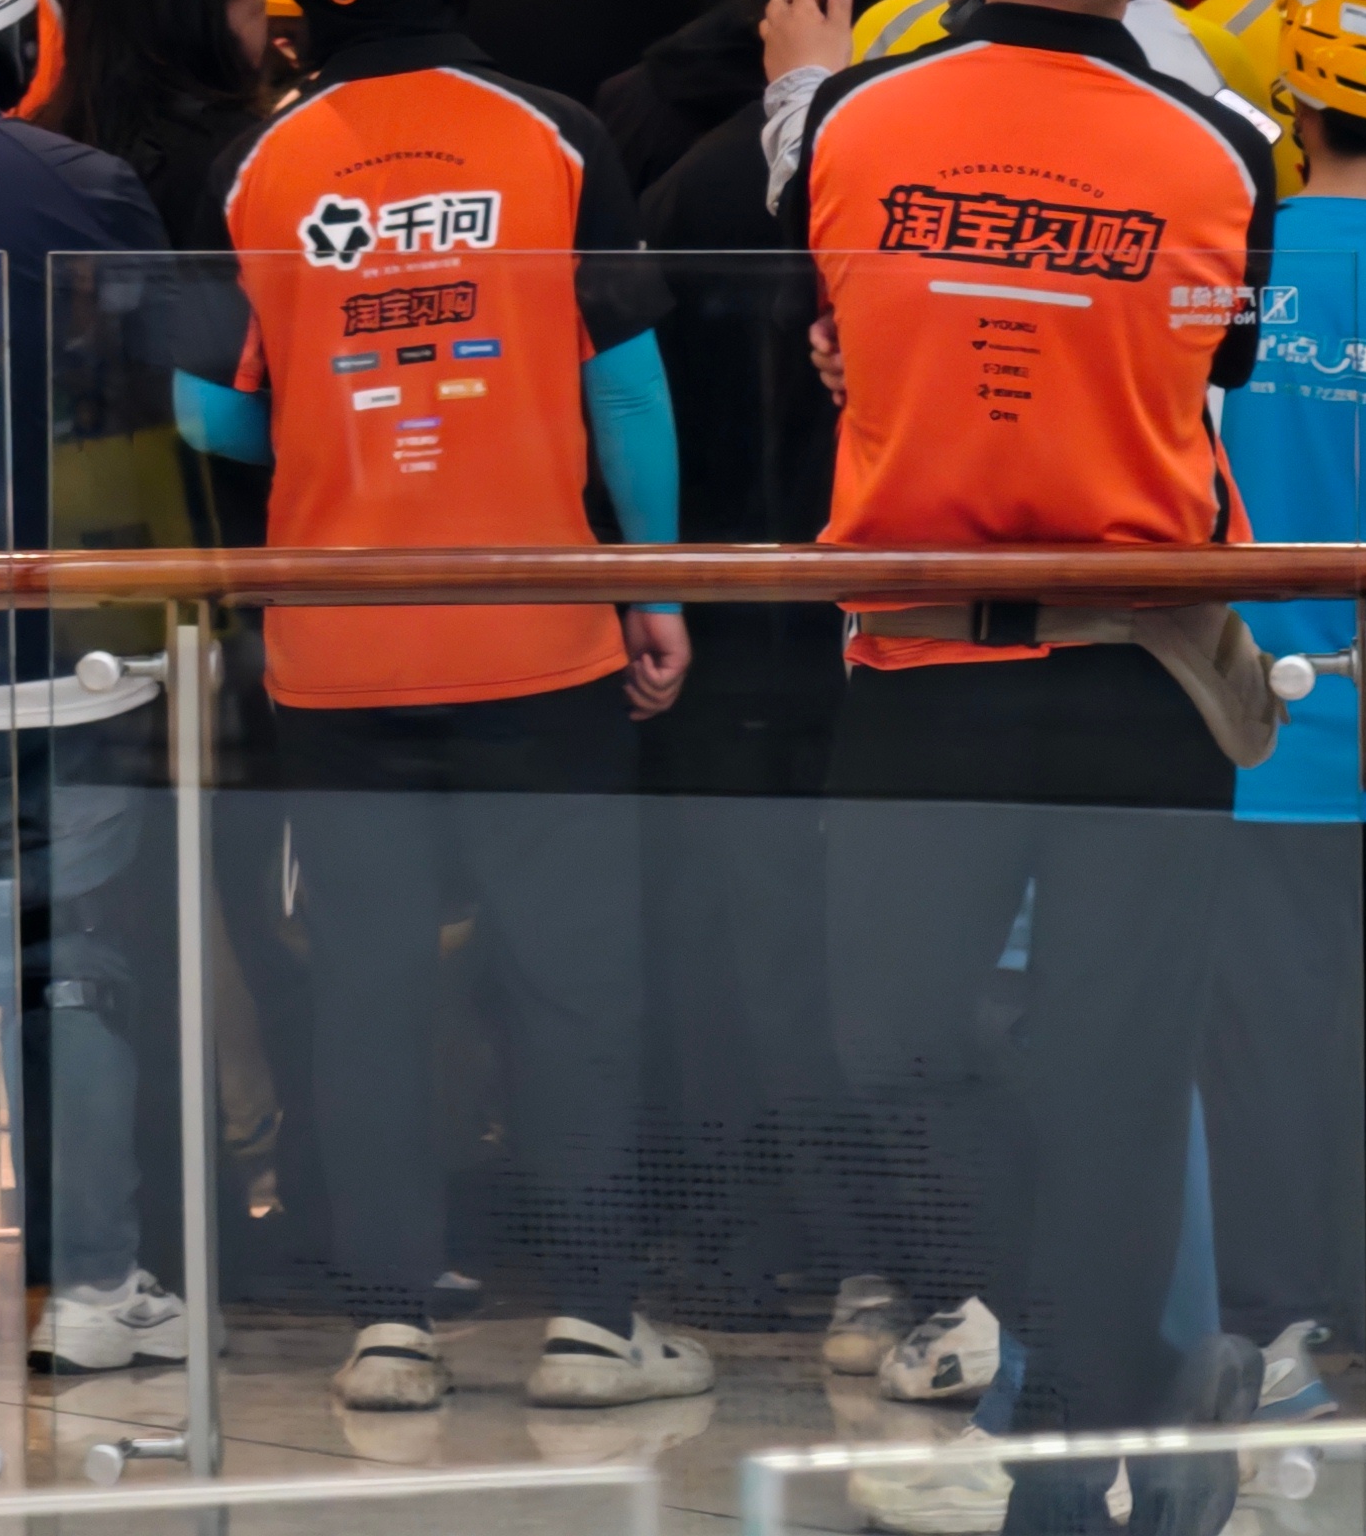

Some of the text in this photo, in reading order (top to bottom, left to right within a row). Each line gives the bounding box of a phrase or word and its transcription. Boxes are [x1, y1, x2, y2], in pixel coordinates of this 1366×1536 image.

[939, 163, 1106, 200] TAOBAOSHANGOU
[382, 194, 496, 251] 千问
[882, 188, 1163, 279] 淘宝闪购
[343, 284, 476, 335] 淘宝闪购
